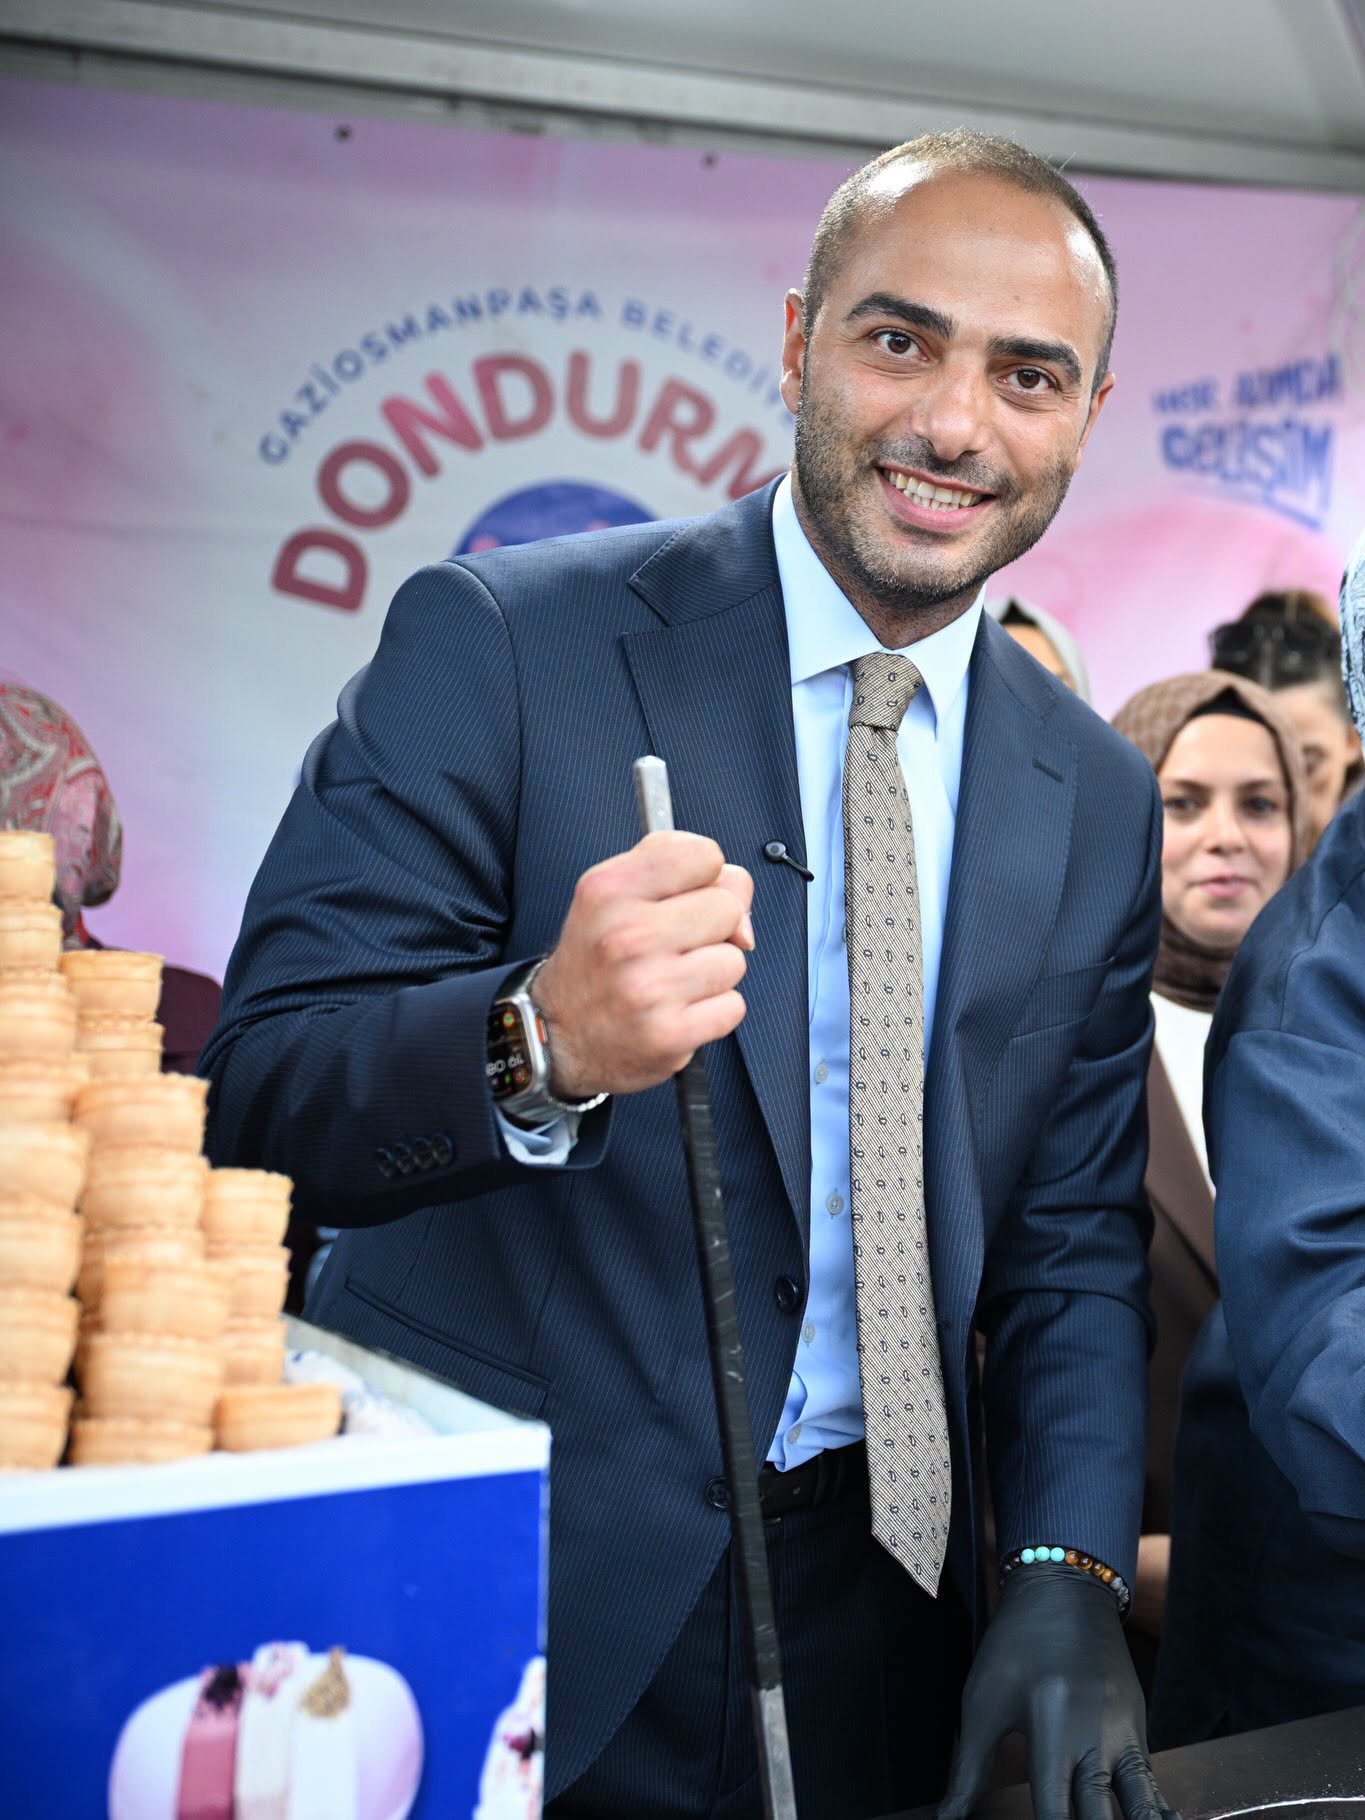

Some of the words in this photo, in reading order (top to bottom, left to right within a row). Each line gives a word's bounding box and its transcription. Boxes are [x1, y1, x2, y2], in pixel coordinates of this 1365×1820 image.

[258, 286, 604, 465] GAZİOSMANPAŞA
[622, 299, 797, 426] BELEDİY
[271, 349, 788, 615] DONDURM
